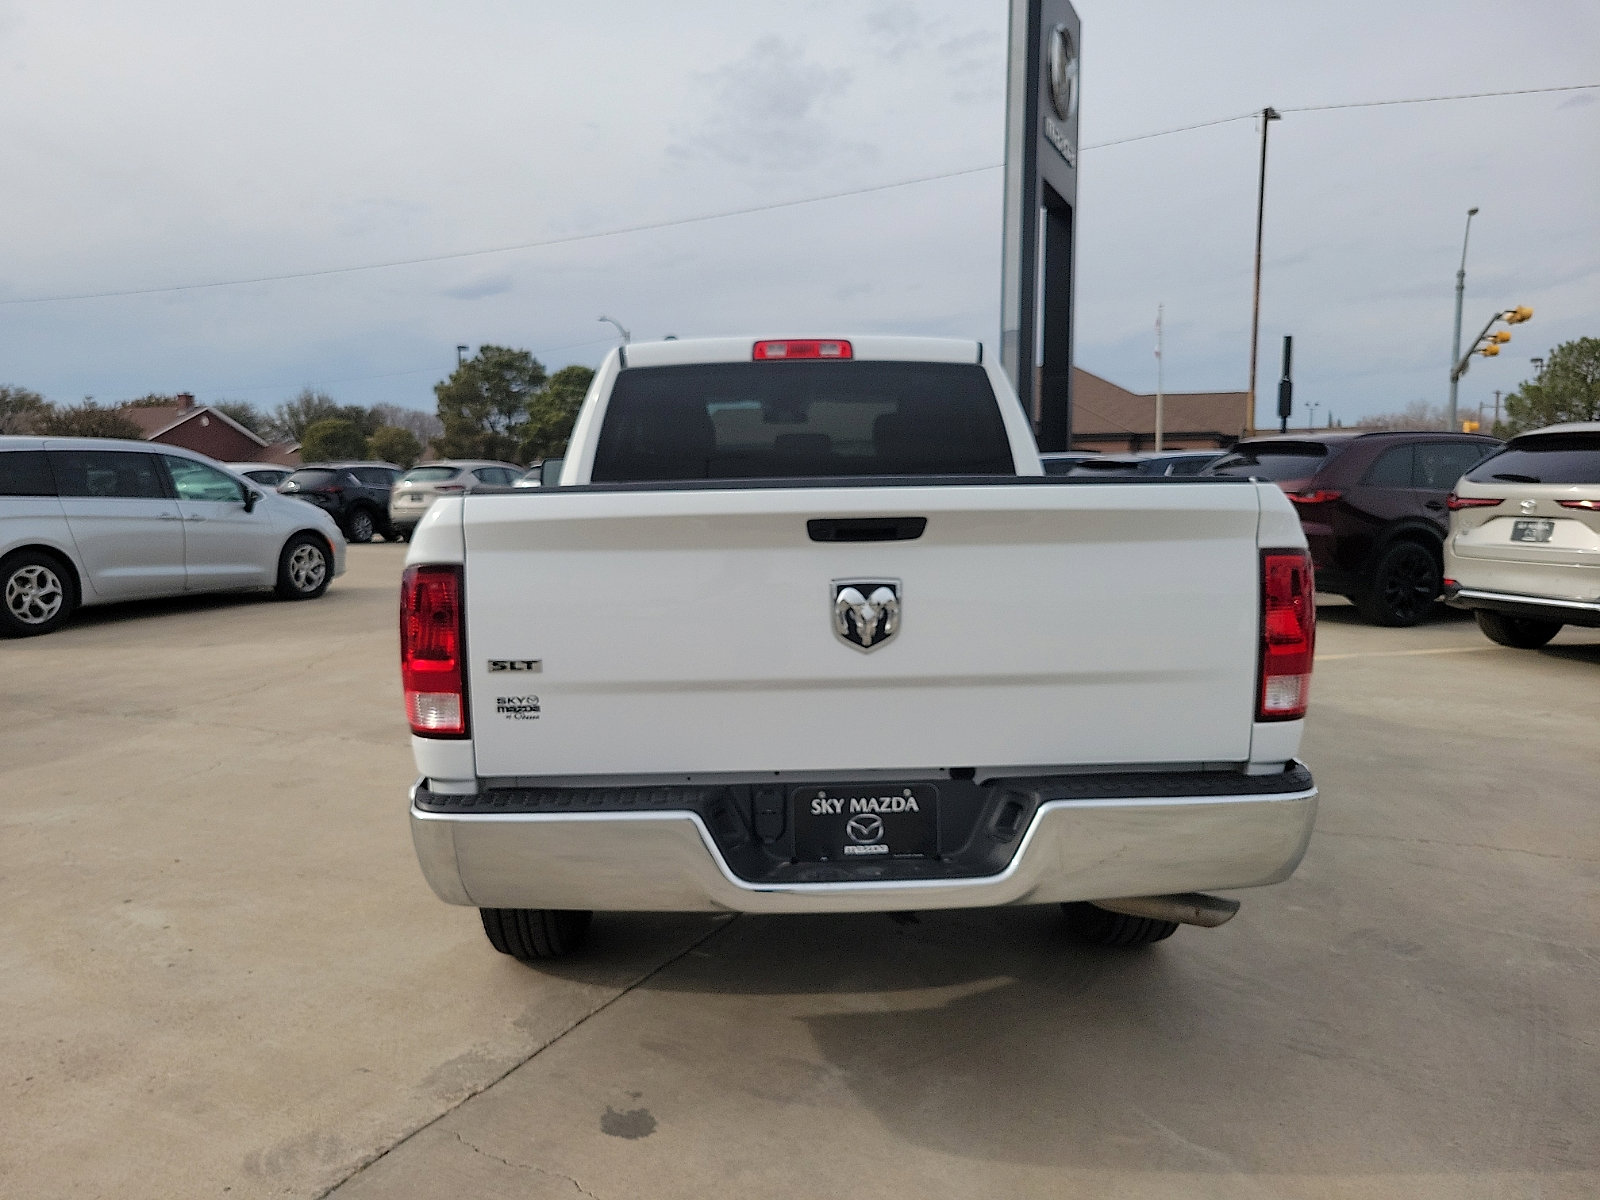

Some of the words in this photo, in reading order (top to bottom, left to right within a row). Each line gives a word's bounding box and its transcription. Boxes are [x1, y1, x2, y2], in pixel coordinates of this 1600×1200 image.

[490, 660, 539, 671] SLT
[496, 696, 525, 705] SKY
[811, 798, 844, 815] SKY
[850, 796, 919, 813] MAZDA
